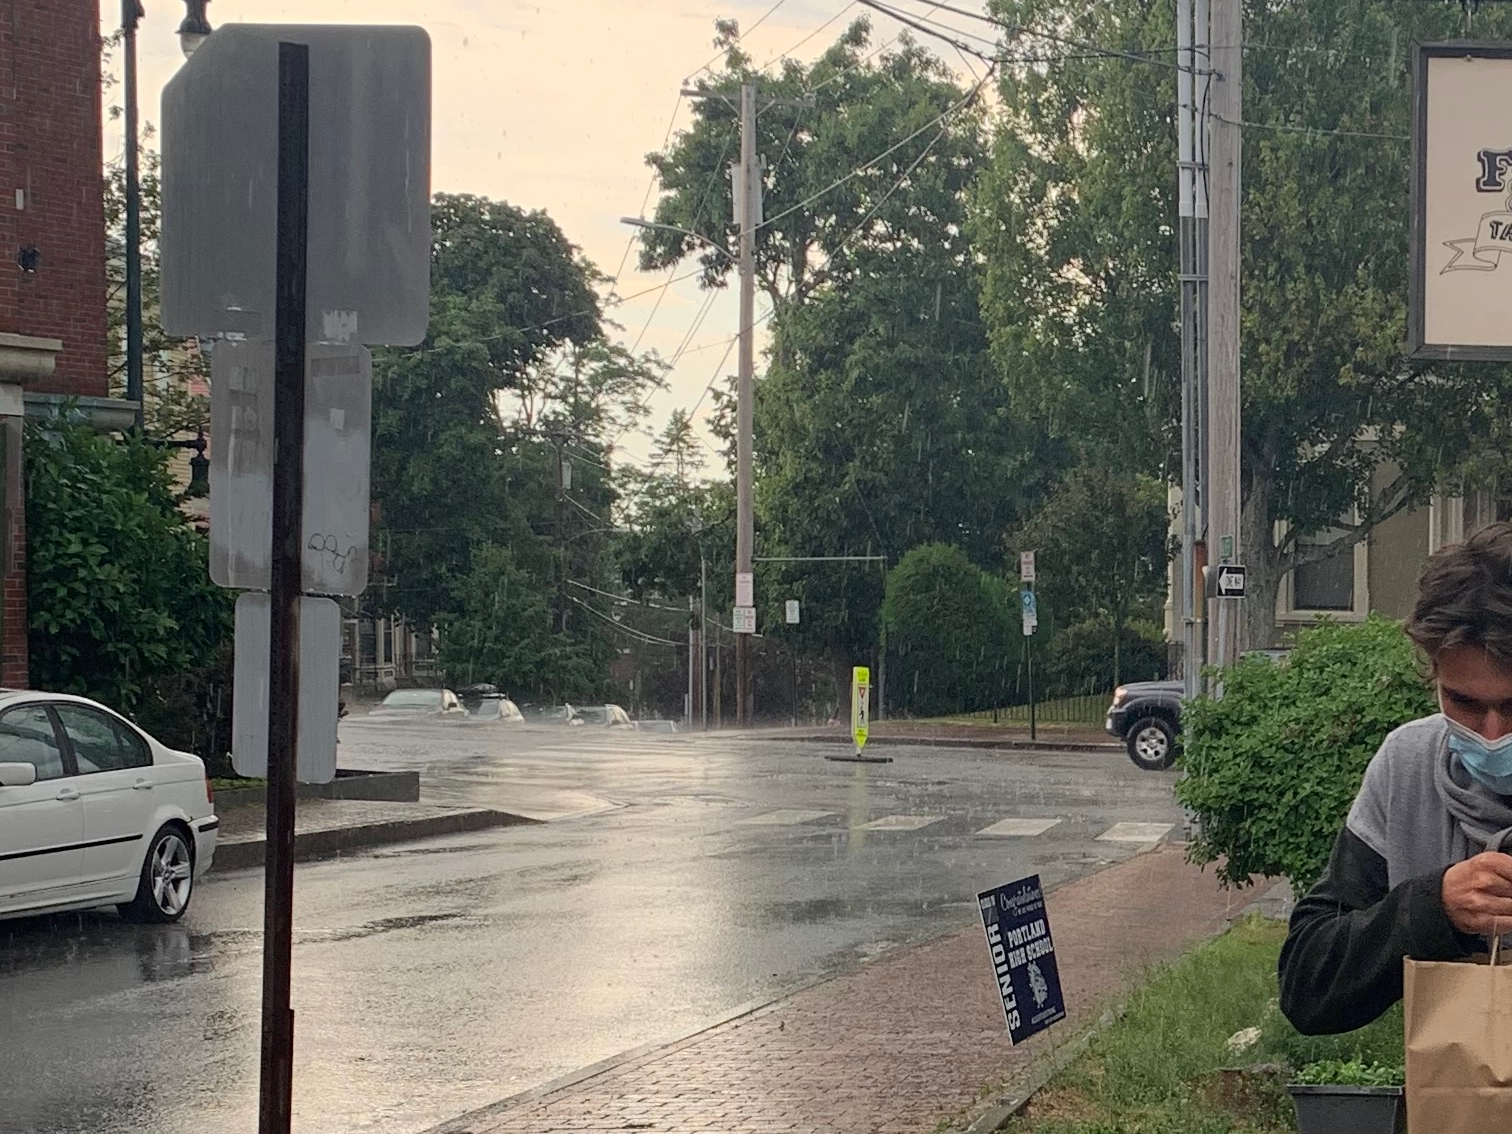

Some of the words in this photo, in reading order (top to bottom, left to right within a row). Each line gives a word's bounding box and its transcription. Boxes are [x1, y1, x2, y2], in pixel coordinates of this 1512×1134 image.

[1006, 918, 1046, 948] PORTLAND
[1007, 947, 1027, 969] HIGH
[1026, 936, 1055, 962] SCHOOL
[986, 922, 1021, 1031] SENIOR
